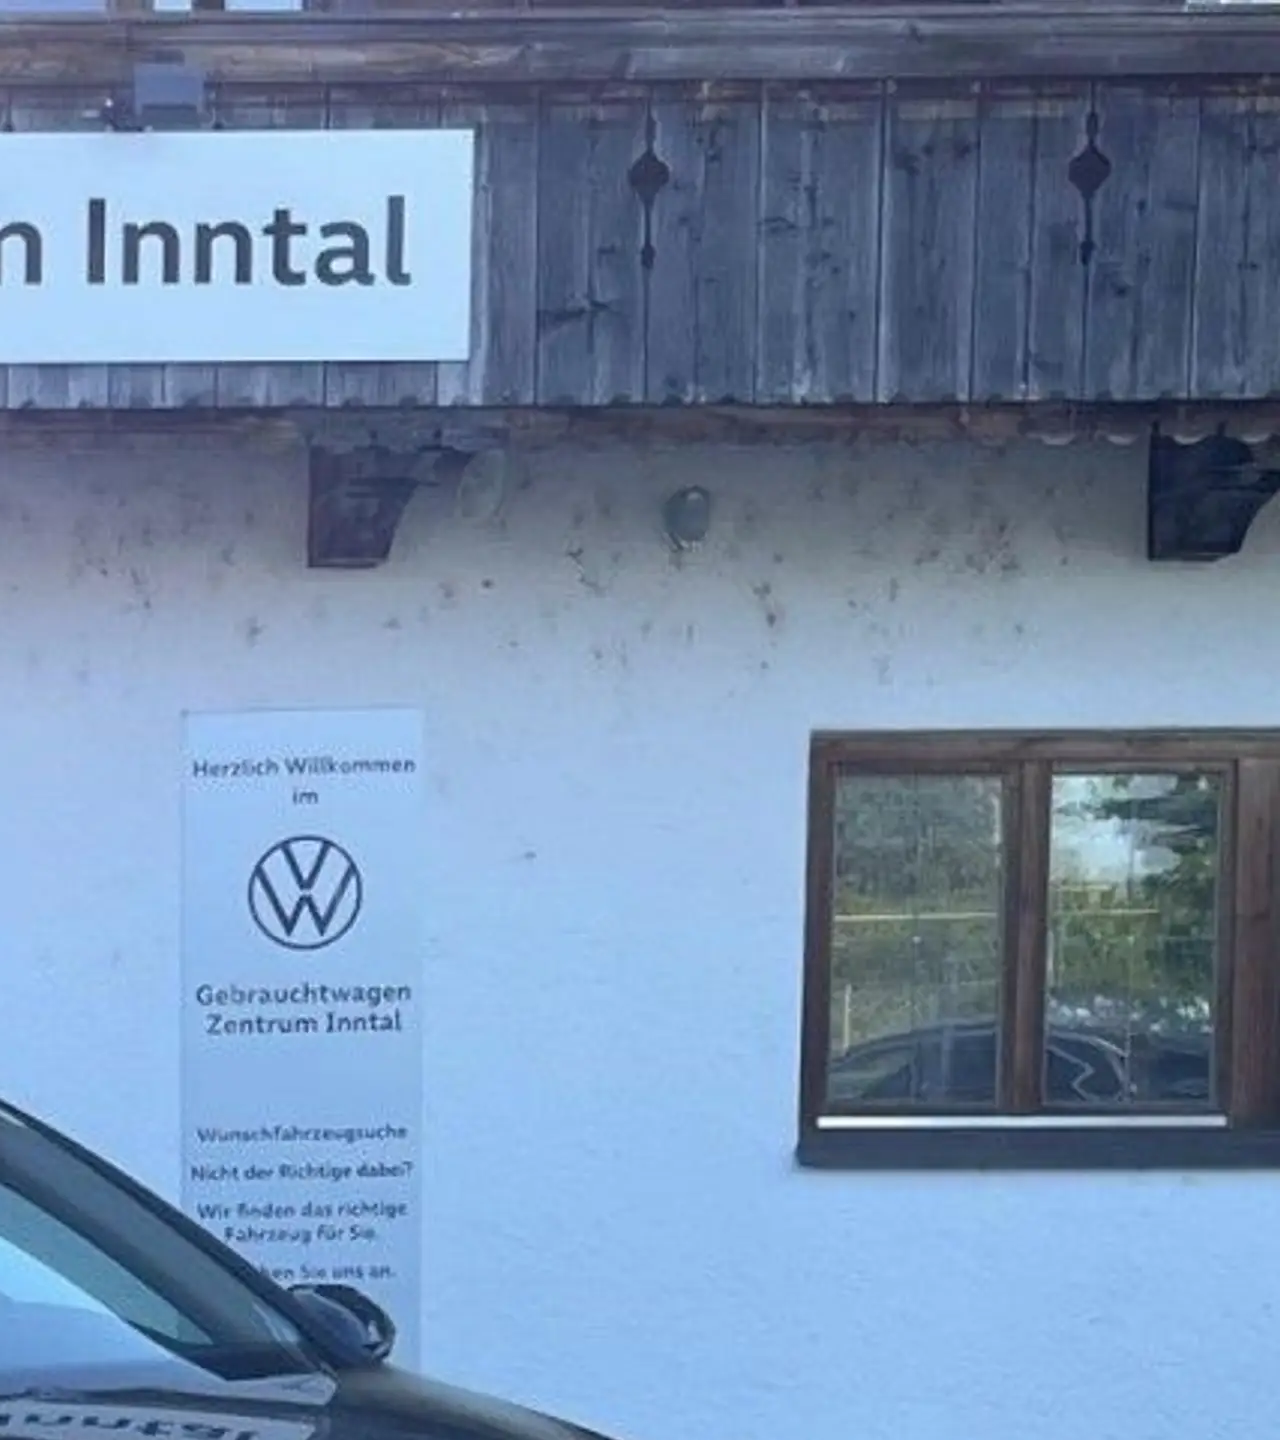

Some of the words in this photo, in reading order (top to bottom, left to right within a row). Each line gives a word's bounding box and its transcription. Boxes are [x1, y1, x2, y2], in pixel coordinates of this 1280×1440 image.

[86, 195, 412, 288] Inntal
[193, 758, 279, 777] Herzlich
[284, 756, 416, 775] Willkommen
[292, 788, 319, 805] im
[196, 983, 412, 1006] Gebrauchtwagen
[206, 1013, 318, 1035] Zentrum
[326, 1008, 402, 1033] Inntal
[197, 1124, 408, 1144] Wunschfahrzeugsuche
[191, 1165, 239, 1181] Nicht
[244, 1165, 274, 1180] der
[278, 1162, 352, 1182] Richtige
[357, 1161, 413, 1178] dabei?
[197, 1203, 231, 1220] Wir
[236, 1202, 296, 1218] finden
[300, 1201, 333, 1217] das
[337, 1200, 408, 1219] richtige
[224, 1226, 312, 1244] Fahrzeug
[316, 1224, 343, 1240] für
[332, 1265, 363, 1279] uns
